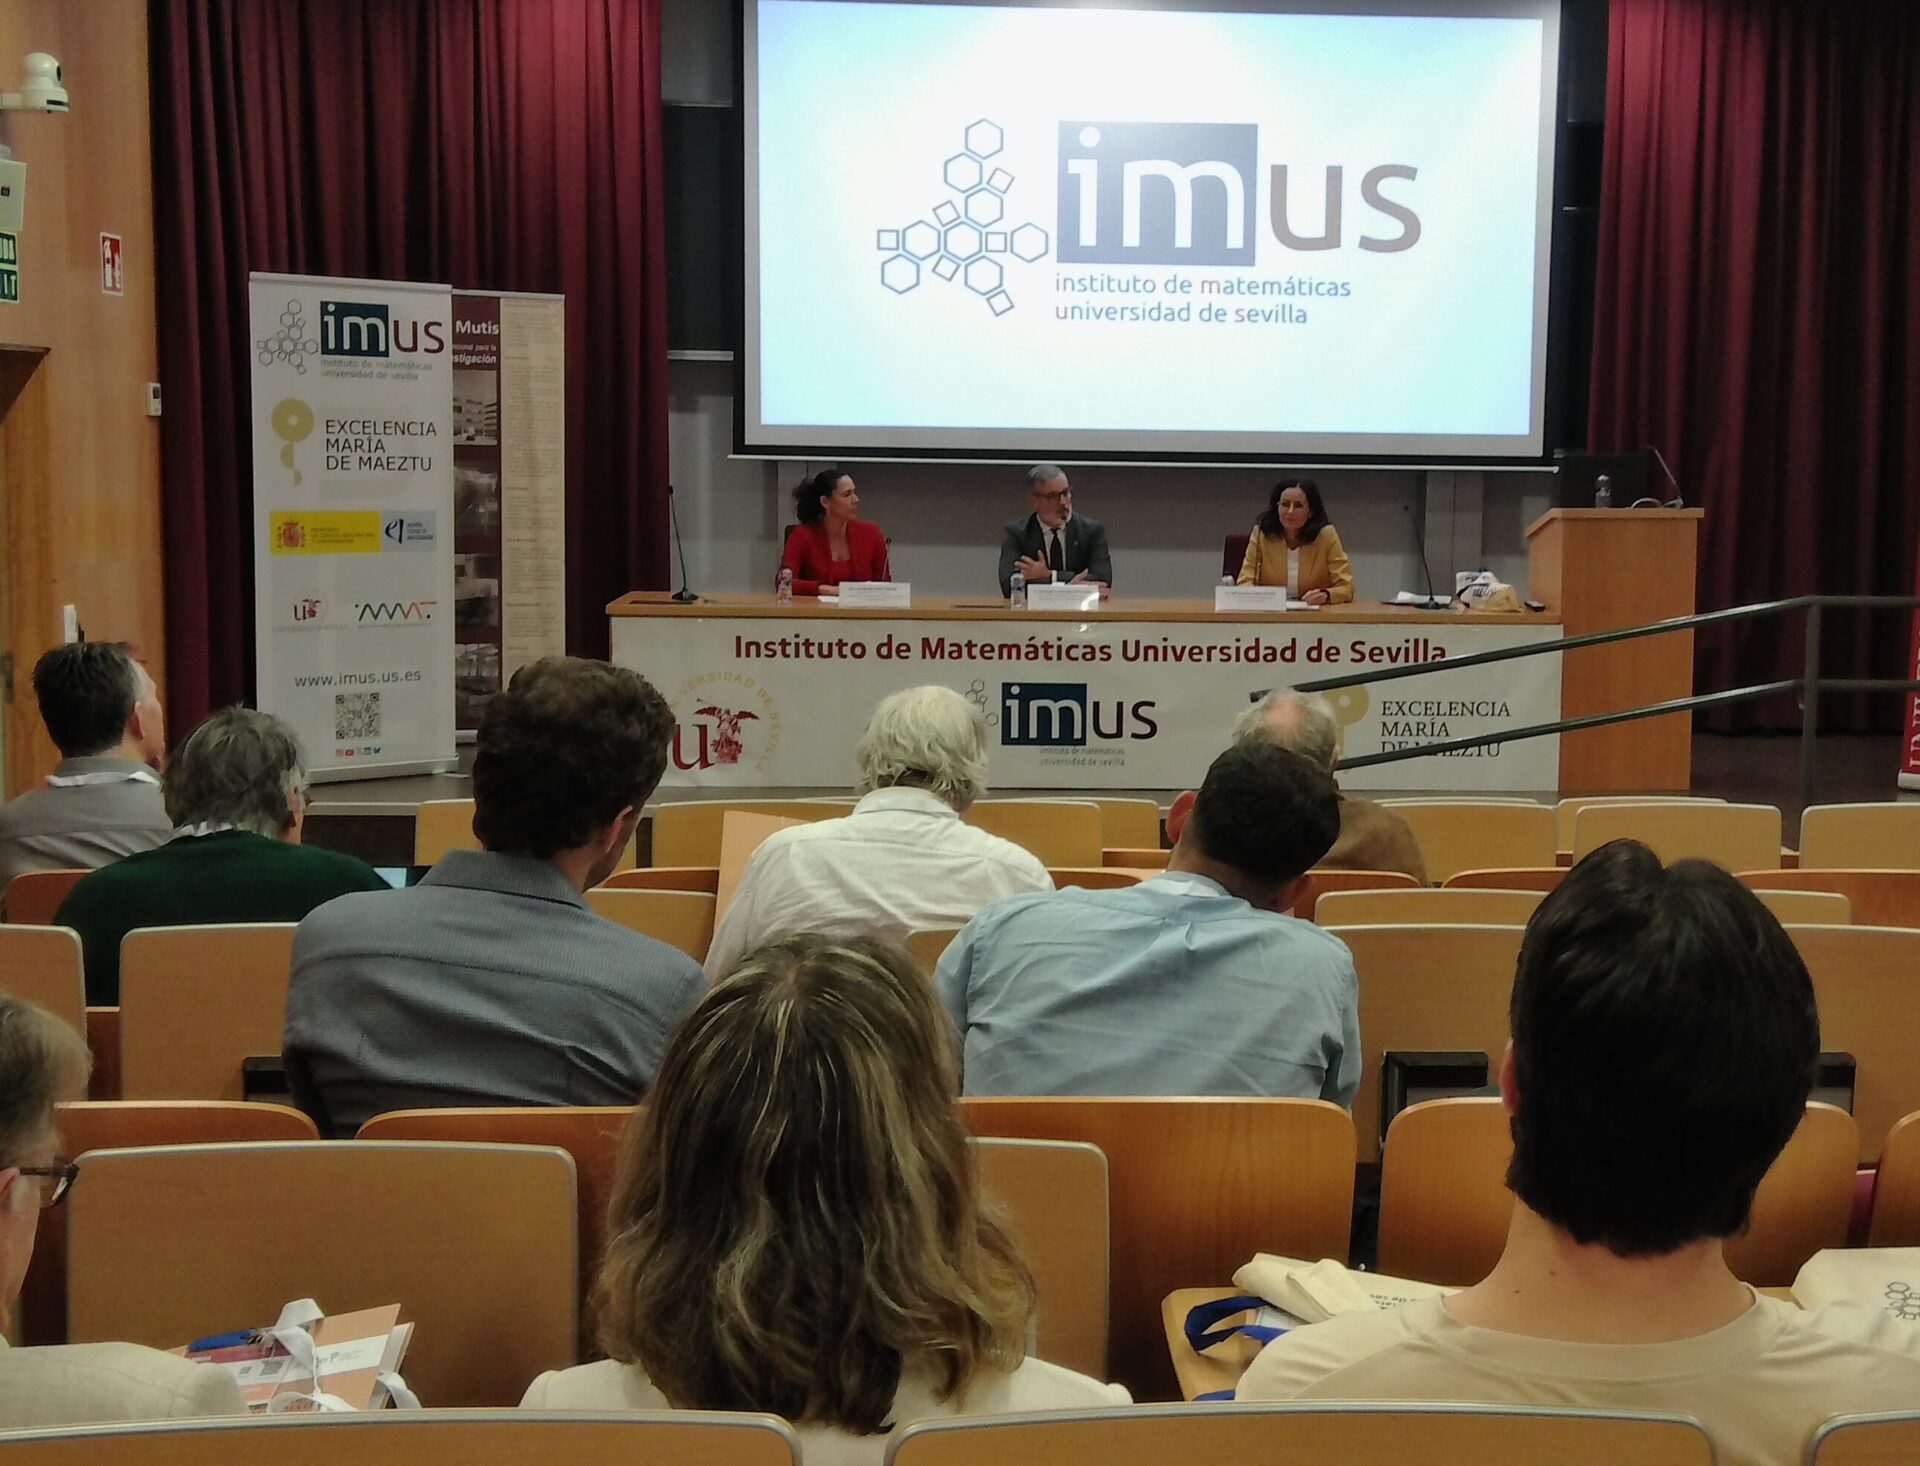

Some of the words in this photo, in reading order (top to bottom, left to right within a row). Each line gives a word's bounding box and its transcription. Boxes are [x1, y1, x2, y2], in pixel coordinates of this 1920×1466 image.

[1067, 124, 1422, 254] imus
[1055, 272, 1157, 295] instituto
[1163, 273, 1193, 296] de
[1200, 274, 1352, 298] matemáticas
[1055, 302, 1191, 323] universidad
[1199, 303, 1229, 323] de
[1235, 304, 1308, 324] sevilla
[323, 302, 445, 354] imus
[455, 320, 500, 336] Mutis
[453, 352, 497, 366] stigación
[325, 419, 437, 437] EXCELENCIA
[325, 436, 386, 454] MARÍA
[326, 456, 351, 471] DE
[358, 456, 432, 472] MAEZTU
[734, 633, 867, 659] Instituto
[876, 634, 911, 660] de
[921, 635, 1112, 663] Matemáticas
[1121, 636, 1297, 664] Universidad
[1306, 637, 1341, 664] de
[1350, 637, 1447, 664] Sevilla
[294, 669, 422, 688] www.imus.us.es
[1004, 684, 1158, 740] imus
[1380, 700, 1511, 717] EXCELENCIA
[1380, 717, 1450, 737] MARÍA
